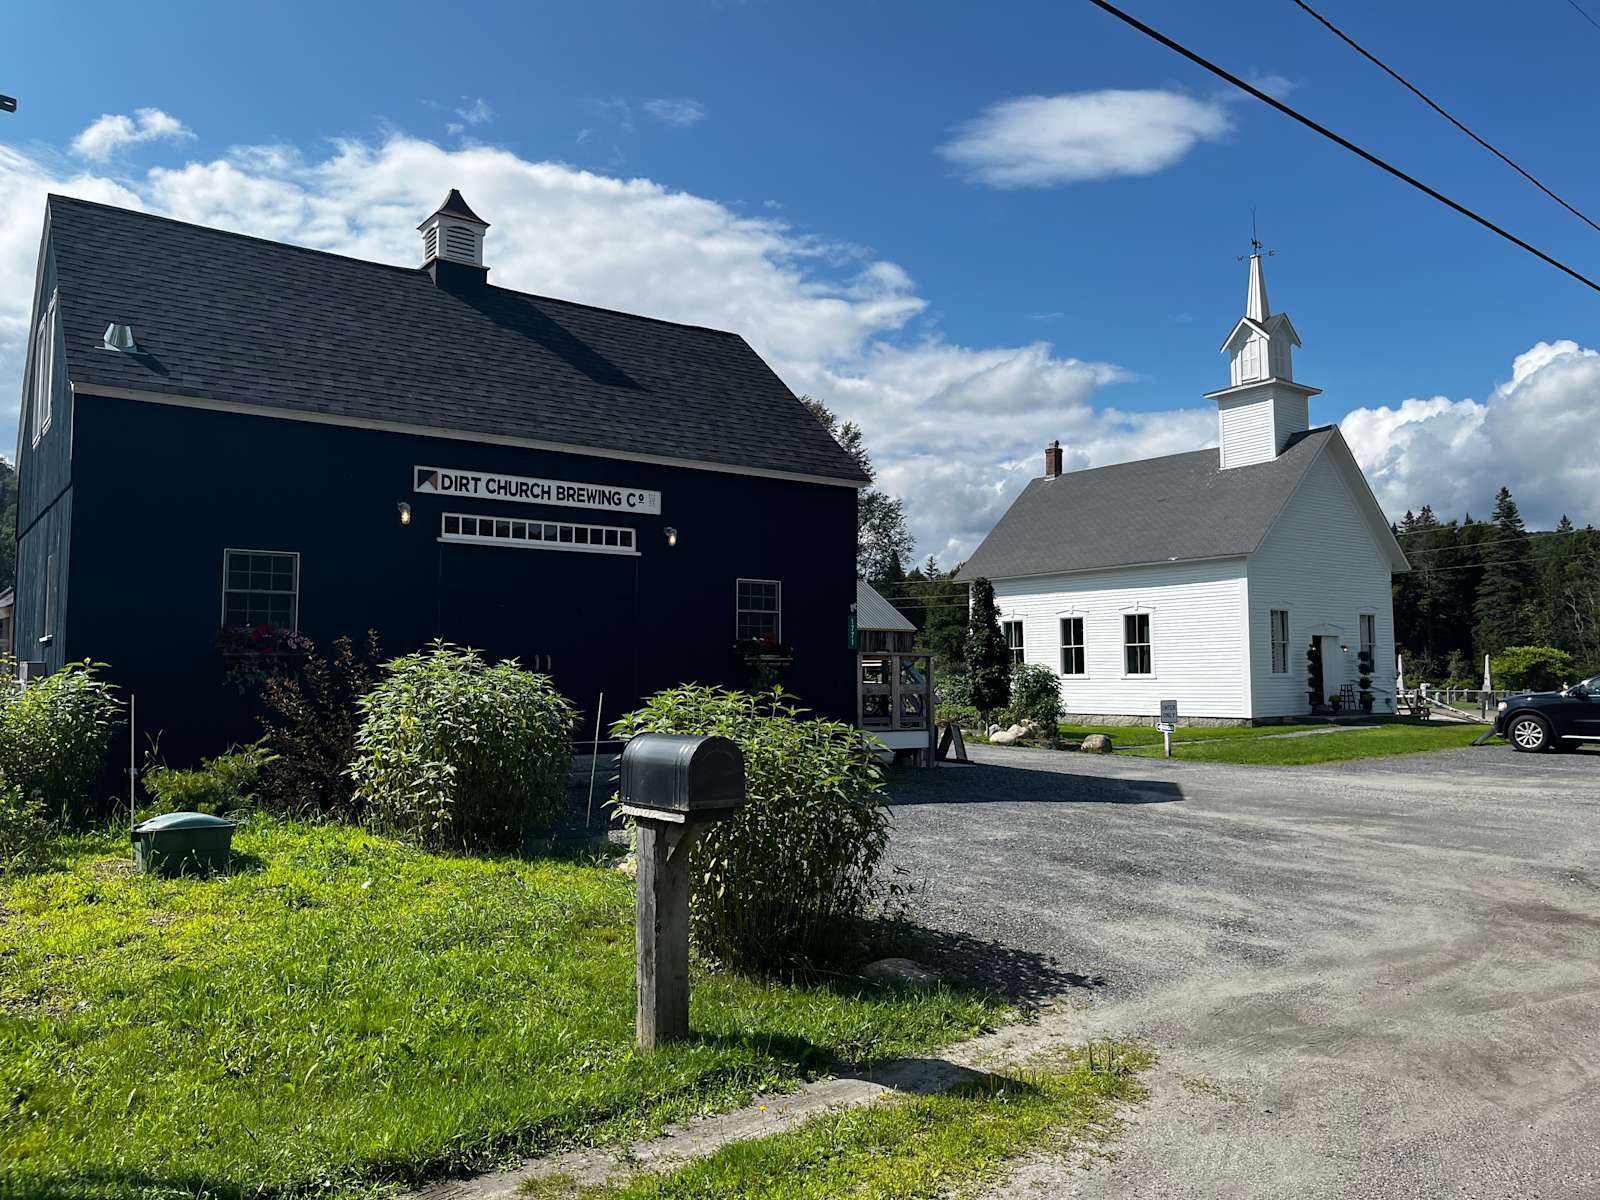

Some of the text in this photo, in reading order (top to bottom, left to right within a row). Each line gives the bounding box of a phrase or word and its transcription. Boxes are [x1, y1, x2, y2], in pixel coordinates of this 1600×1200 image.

[441, 473, 482, 494] DIRT
[485, 478, 552, 500] CHURCH
[556, 485, 622, 506] BREWING
